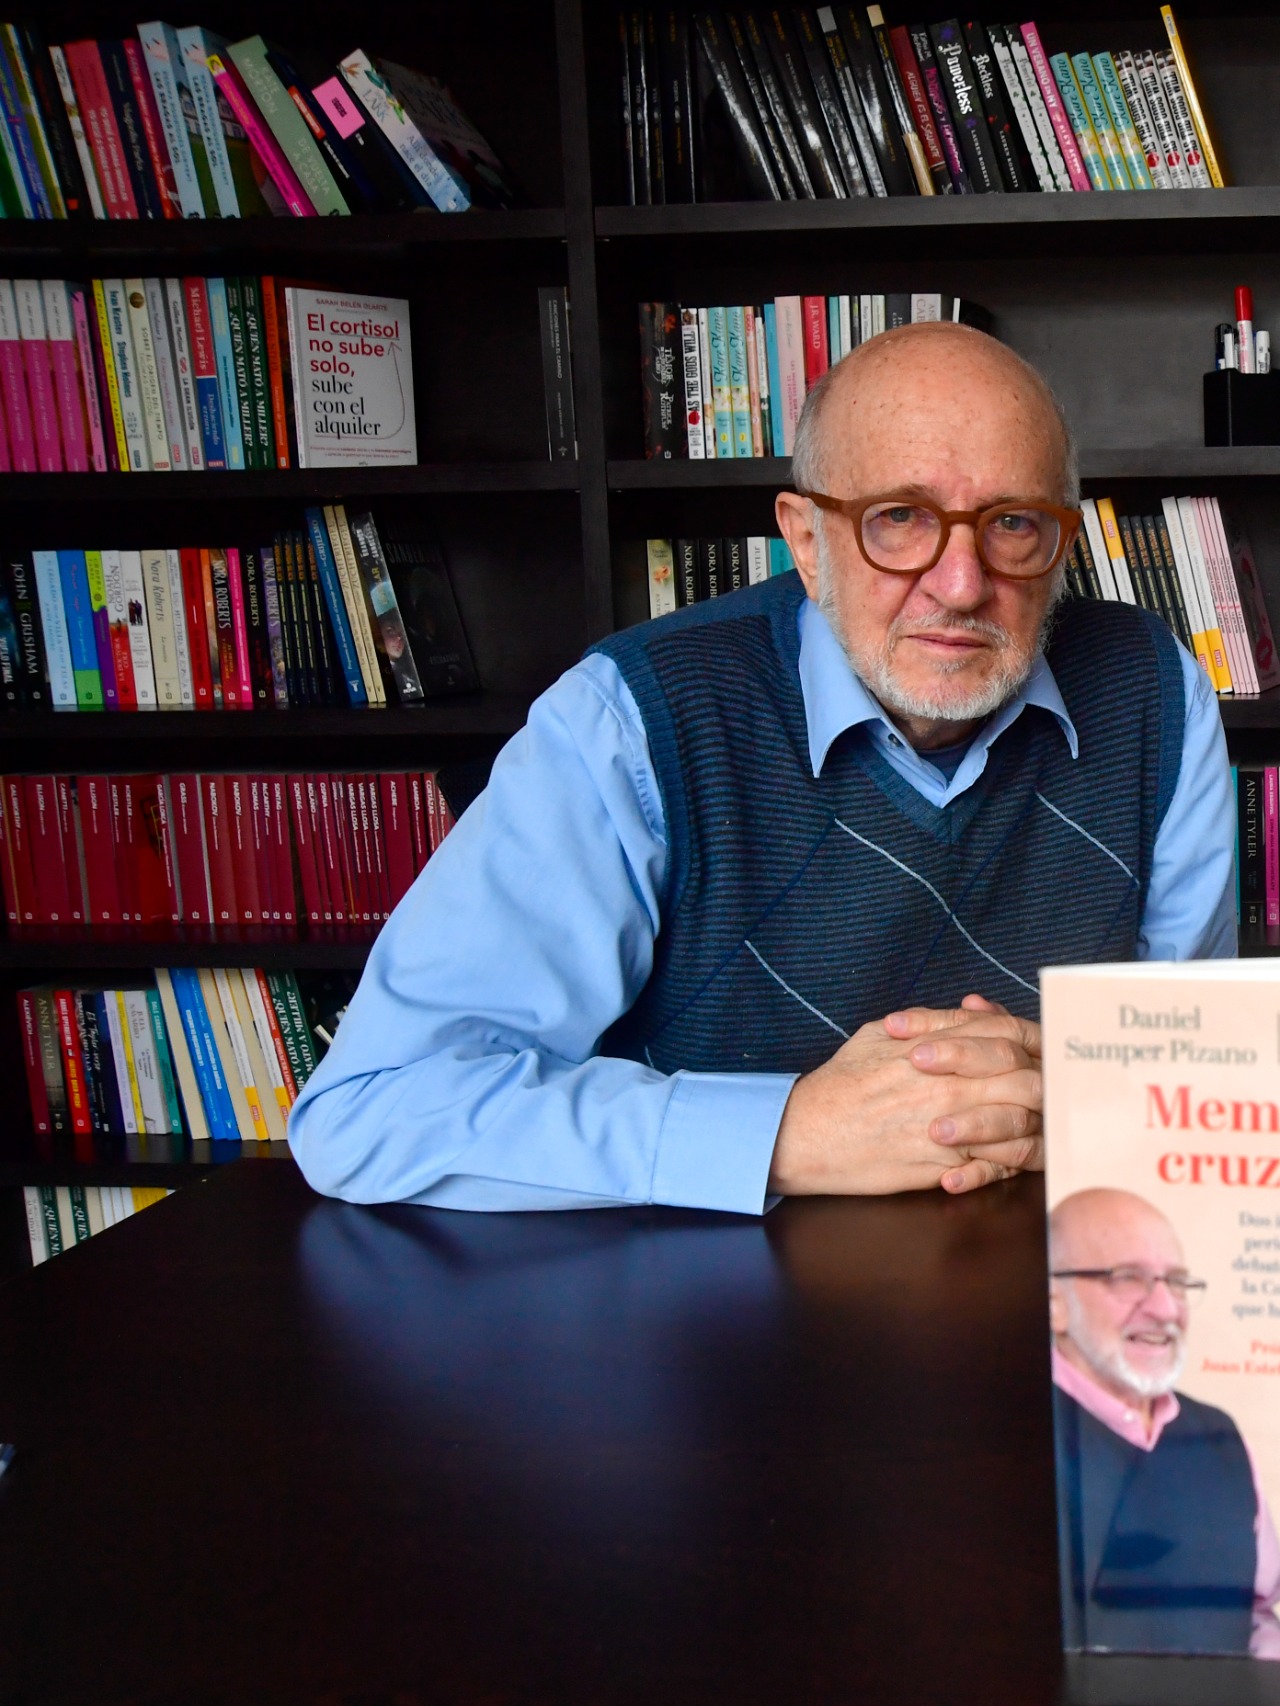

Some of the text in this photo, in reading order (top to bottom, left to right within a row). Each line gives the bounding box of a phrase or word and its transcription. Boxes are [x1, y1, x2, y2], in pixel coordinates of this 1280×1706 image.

[1026, 32, 1039, 46] UN
[938, 42, 974, 115] Powerless
[971, 53, 993, 99] Reckless
[1002, 58, 1016, 89] Powerful
[1020, 57, 1036, 88] Powerful
[1030, 47, 1051, 85] VERANO
[906, 71, 940, 158] ALGUIEN ES EL SIGUIENTE
[1046, 94, 1057, 108] NY
[1143, 72, 1178, 153] AS THE GODS WILL
[1164, 72, 1198, 153] AS THE GODS WILL
[206, 135, 213, 146] AL
[209, 150, 217, 168] SOL
[970, 129, 991, 187] LAUREN ROBERTS
[999, 130, 1019, 188] LAUREN ROBERTS
[141, 327, 150, 351] SOBRE
[190, 287, 209, 370] Michael Lewis
[229, 312, 241, 352] ¿QUIÉN
[307, 313, 400, 338] El cortisol
[810, 304, 821, 349] J.R. WARD
[110, 291, 132, 398] Ivan Krastev Stephen Holmes
[145, 354, 151, 363] EL
[309, 338, 384, 357] no sube
[147, 364, 158, 394] ORIGEN
[236, 354, 248, 387] MATÓ
[245, 311, 268, 447] ¿QUIÉN MATÓ A MILLER?
[310, 355, 355, 378] solo,
[683, 331, 700, 413] AS THE GODS WILL
[240, 389, 247, 398] A
[311, 375, 353, 395] sube
[202, 405, 211, 435] errores
[207, 393, 221, 445] Deshaciendo
[313, 397, 365, 415] con el
[154, 410, 164, 440] TIEMPO
[241, 400, 253, 447] MILLER?
[314, 415, 381, 440] alquiler
[211, 559, 226, 586] NORA
[730, 543, 740, 572] NORA
[754, 546, 762, 570] JULIA
[105, 574, 116, 604] NOAH
[110, 565, 124, 612] GORDON
[150, 559, 165, 622] Nora Roberts
[245, 554, 260, 627] NORA ROBERTS
[263, 557, 280, 627] NORA ROBERTS
[11, 563, 39, 674] JOHN GRISHAM
[215, 587, 232, 629] ROBERTS
[114, 637, 124, 682] LA DOCTORA
[36, 784, 46, 811] ELLISON
[60, 782, 69, 811] CANETTI
[89, 782, 98, 810] ELLISON
[111, 784, 120, 817] KOESTLER
[125, 784, 133, 817] KOESTLER
[157, 784, 167, 825] GARCÍA LORCA
[179, 782, 188, 804] GRASS
[209, 782, 219, 817] NABOKOV
[232, 782, 242, 817] NABOKOV
[251, 782, 259, 811] THOMAS
[262, 782, 271, 818] McCARTHY
[274, 783, 282, 811] SONTAG
[293, 782, 302, 810] SONTAG
[307, 782, 316, 814] MOLANO
[320, 782, 328, 808] OSPINA
[347, 782, 358, 831] VARGAS LLOSA
[358, 782, 369, 831] VARGAS LLOSA
[368, 782, 380, 830] VARGAS LLOSA
[390, 780, 398, 806] ACHEBE
[412, 780, 420, 811] GAMBOA
[425, 780, 434, 815] CORTÁZAR
[1246, 778, 1257, 859] ANNE TYLER
[23, 998, 34, 1035] ALEXIÉVICH
[286, 991, 305, 1033] MILLER?
[1118, 1004, 1201, 1031] Daniel
[38, 998, 56, 1070] ANNE TYLER
[272, 997, 291, 1034] ¿QUIÉN
[283, 1035, 299, 1065] MATÓ
[292, 1066, 302, 1074] A
[298, 1034, 307, 1043] A
[1064, 1038, 1259, 1066] Samper Pizano
[44, 1204, 60, 1240] ¿QUIÉN
[1239, 1212, 1271, 1228] Dos
[1241, 1277, 1257, 1294] la
[1231, 1302, 1263, 1320] que
[1202, 1357, 1240, 1373] Juan
